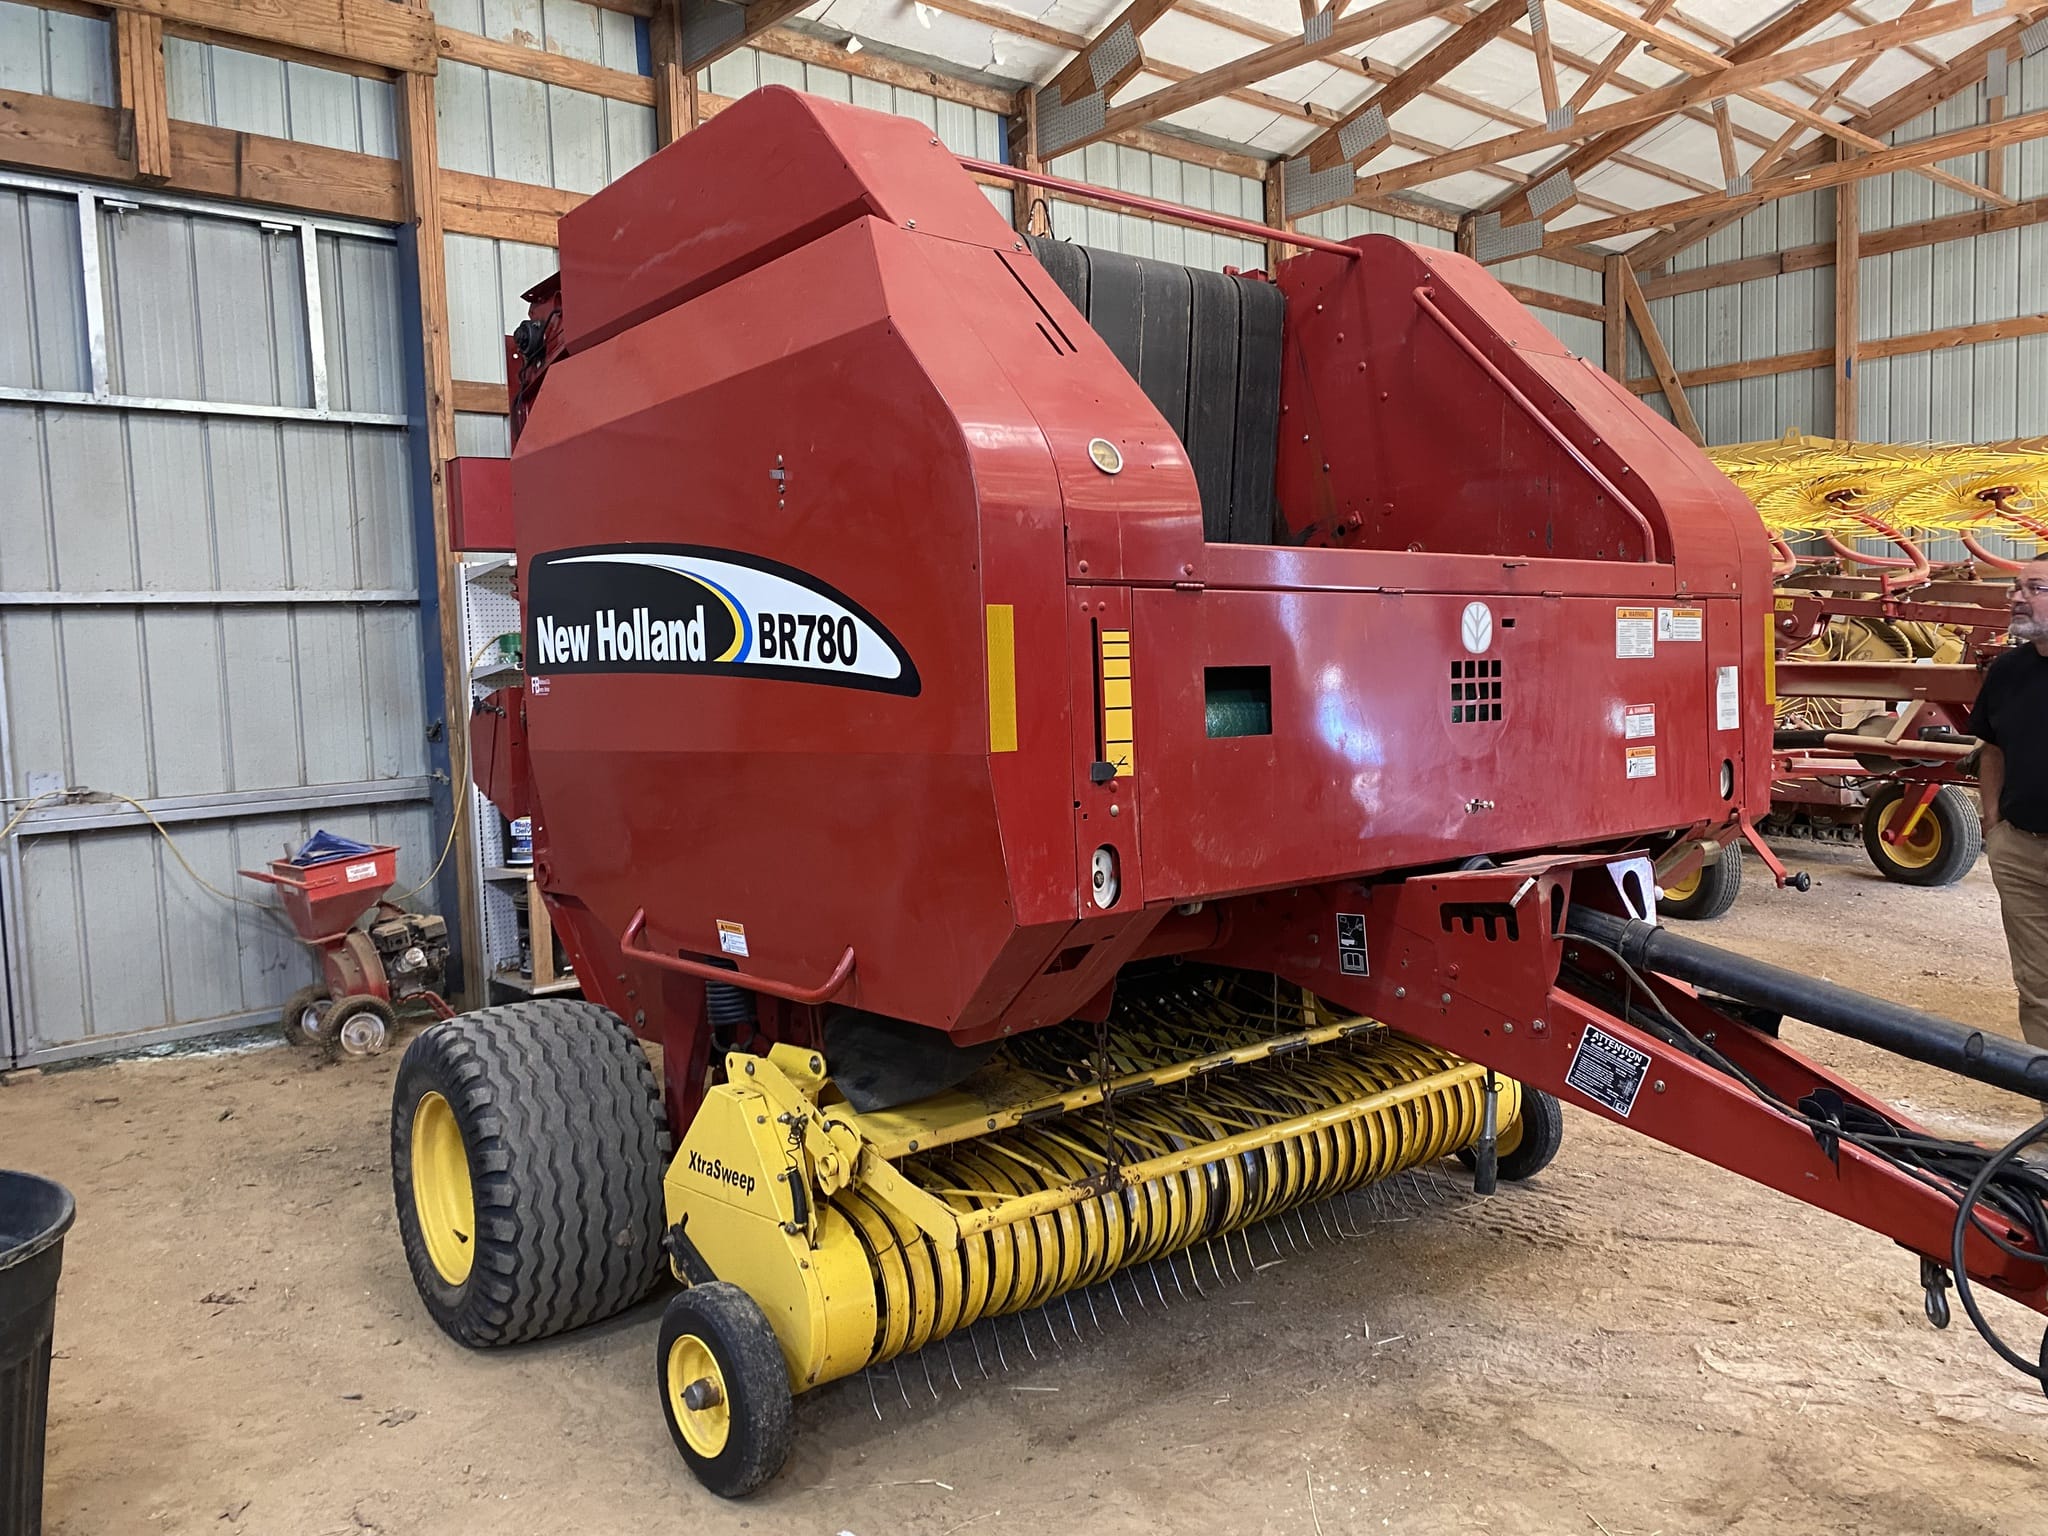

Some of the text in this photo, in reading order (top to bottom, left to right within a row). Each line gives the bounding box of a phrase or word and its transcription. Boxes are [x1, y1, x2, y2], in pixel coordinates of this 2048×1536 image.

[536, 605, 858, 666] New Holland BR780
[1592, 1031, 1642, 1063] ATTENTION
[688, 1149, 755, 1196] XtraSweep
